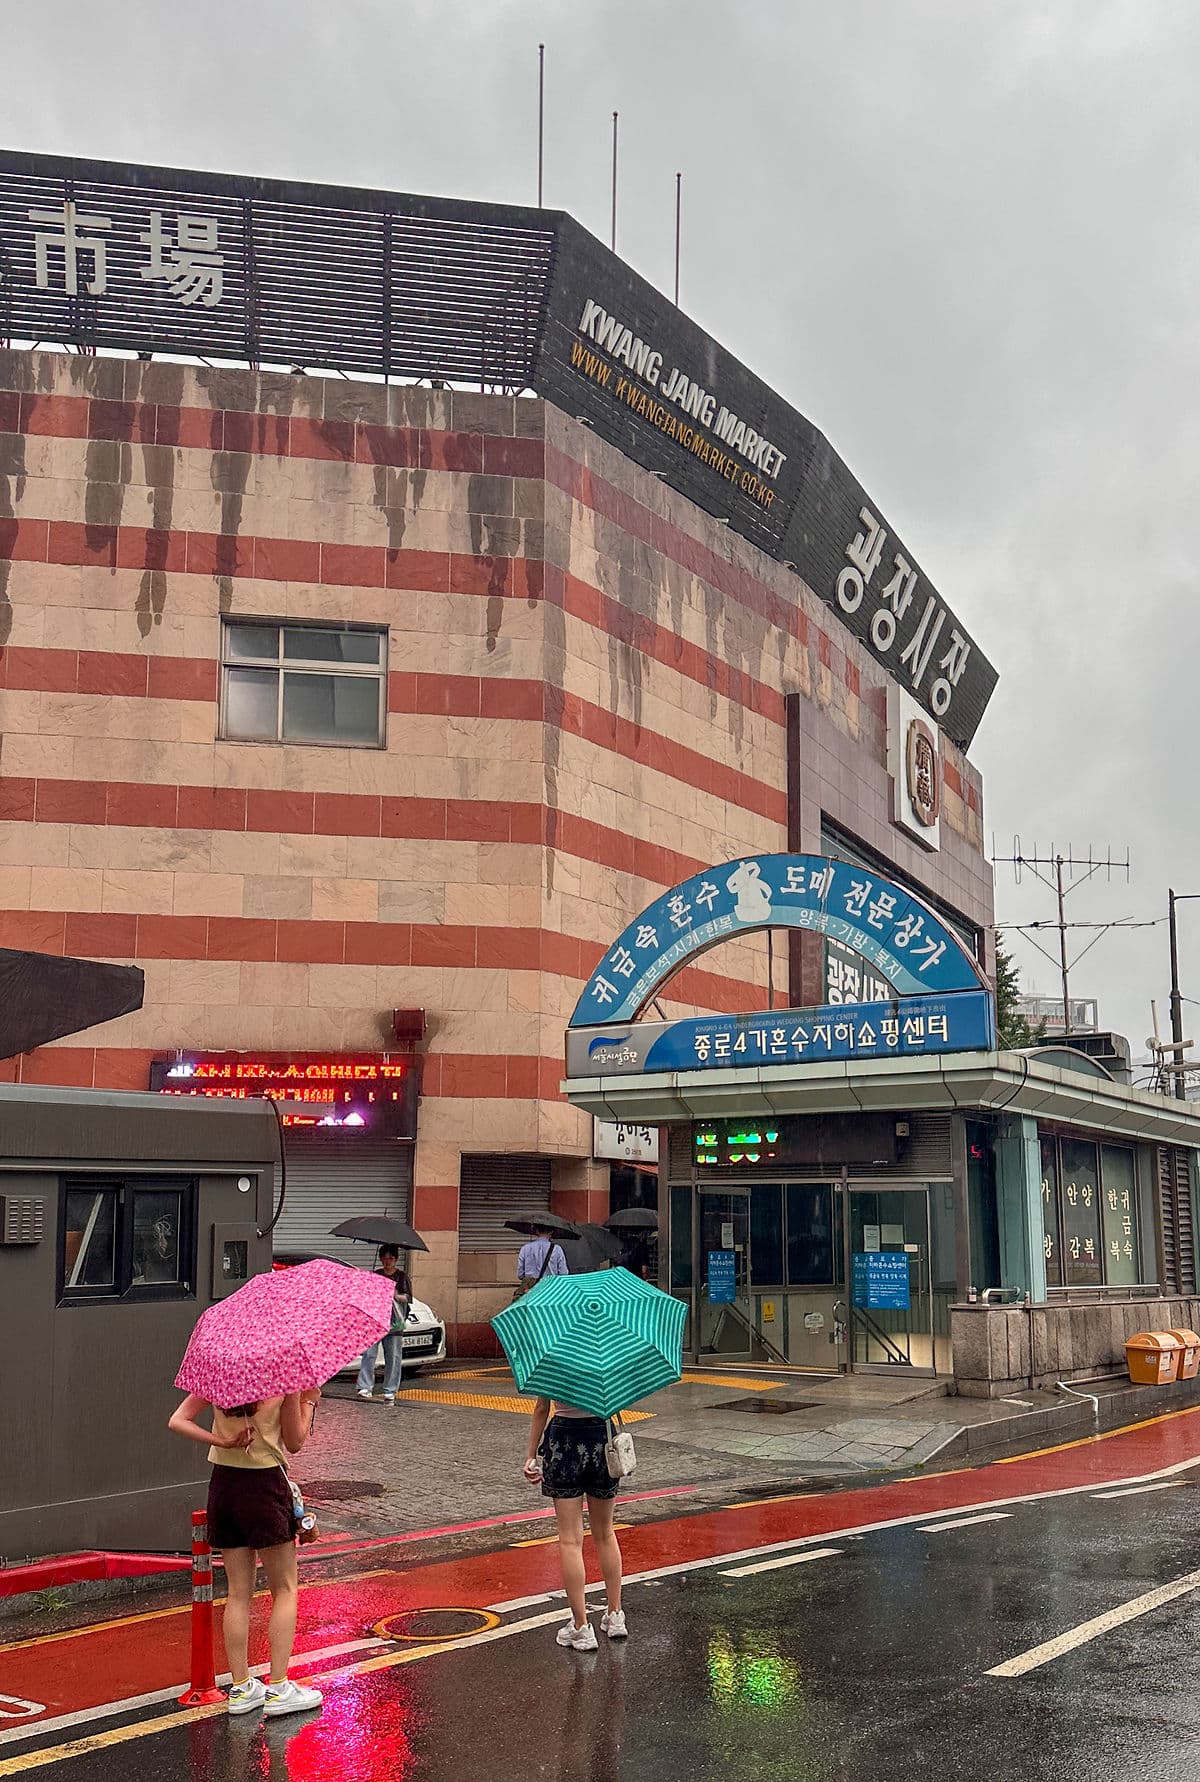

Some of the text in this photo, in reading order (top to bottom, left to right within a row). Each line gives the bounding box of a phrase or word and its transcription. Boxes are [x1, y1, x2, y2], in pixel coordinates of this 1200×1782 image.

[28, 201, 225, 308] 市場
[579, 298, 788, 480] KWANG JANG MARKET
[835, 507, 971, 716] 광장시장
[591, 866, 947, 1004] 귀금속 혼수 도매 전문상가
[592, 1046, 638, 1066] 서울시설공단
[776, 1016, 803, 1026] WEDDING
[805, 1013, 835, 1024] SHOPPING
[836, 1012, 859, 1021] CENTER
